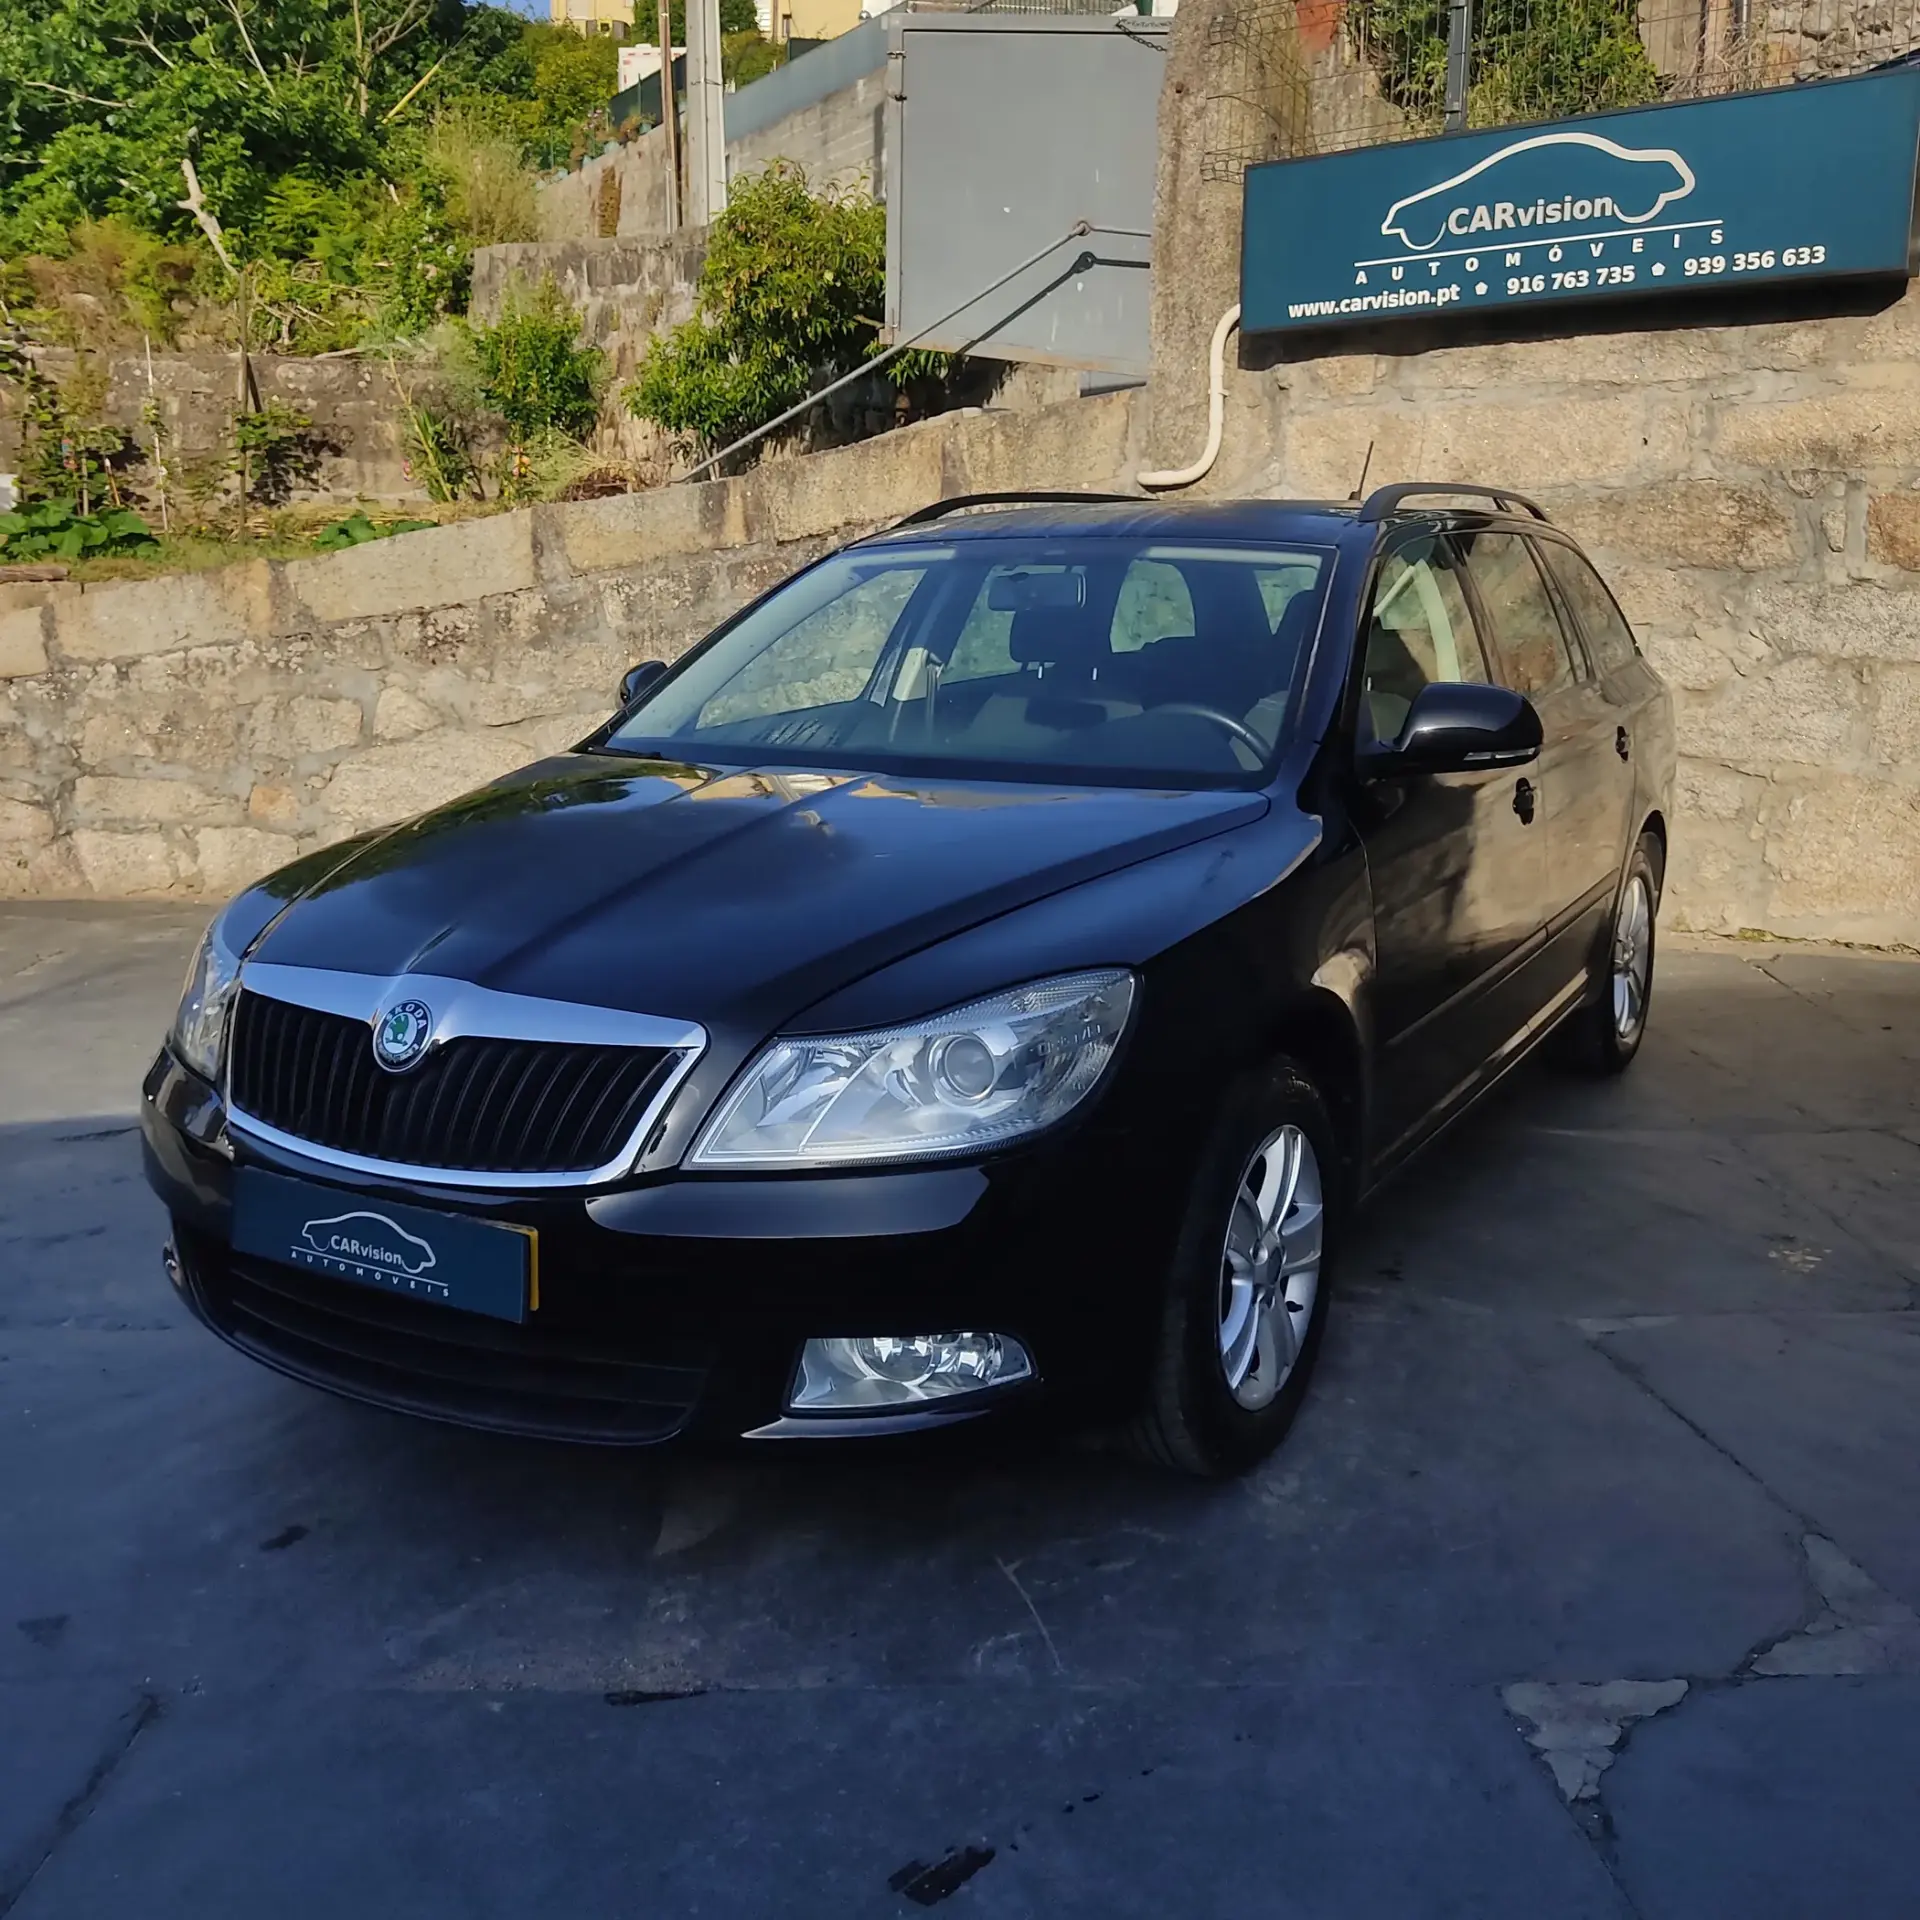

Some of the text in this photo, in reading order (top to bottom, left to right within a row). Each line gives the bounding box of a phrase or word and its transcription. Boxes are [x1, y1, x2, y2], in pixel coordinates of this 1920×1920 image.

[1447, 195, 1613, 236] CARvision
[1287, 245, 1826, 319] www.carvision.pt 916 763 735 939 356 633
[330, 1234, 402, 1265] CARvision
